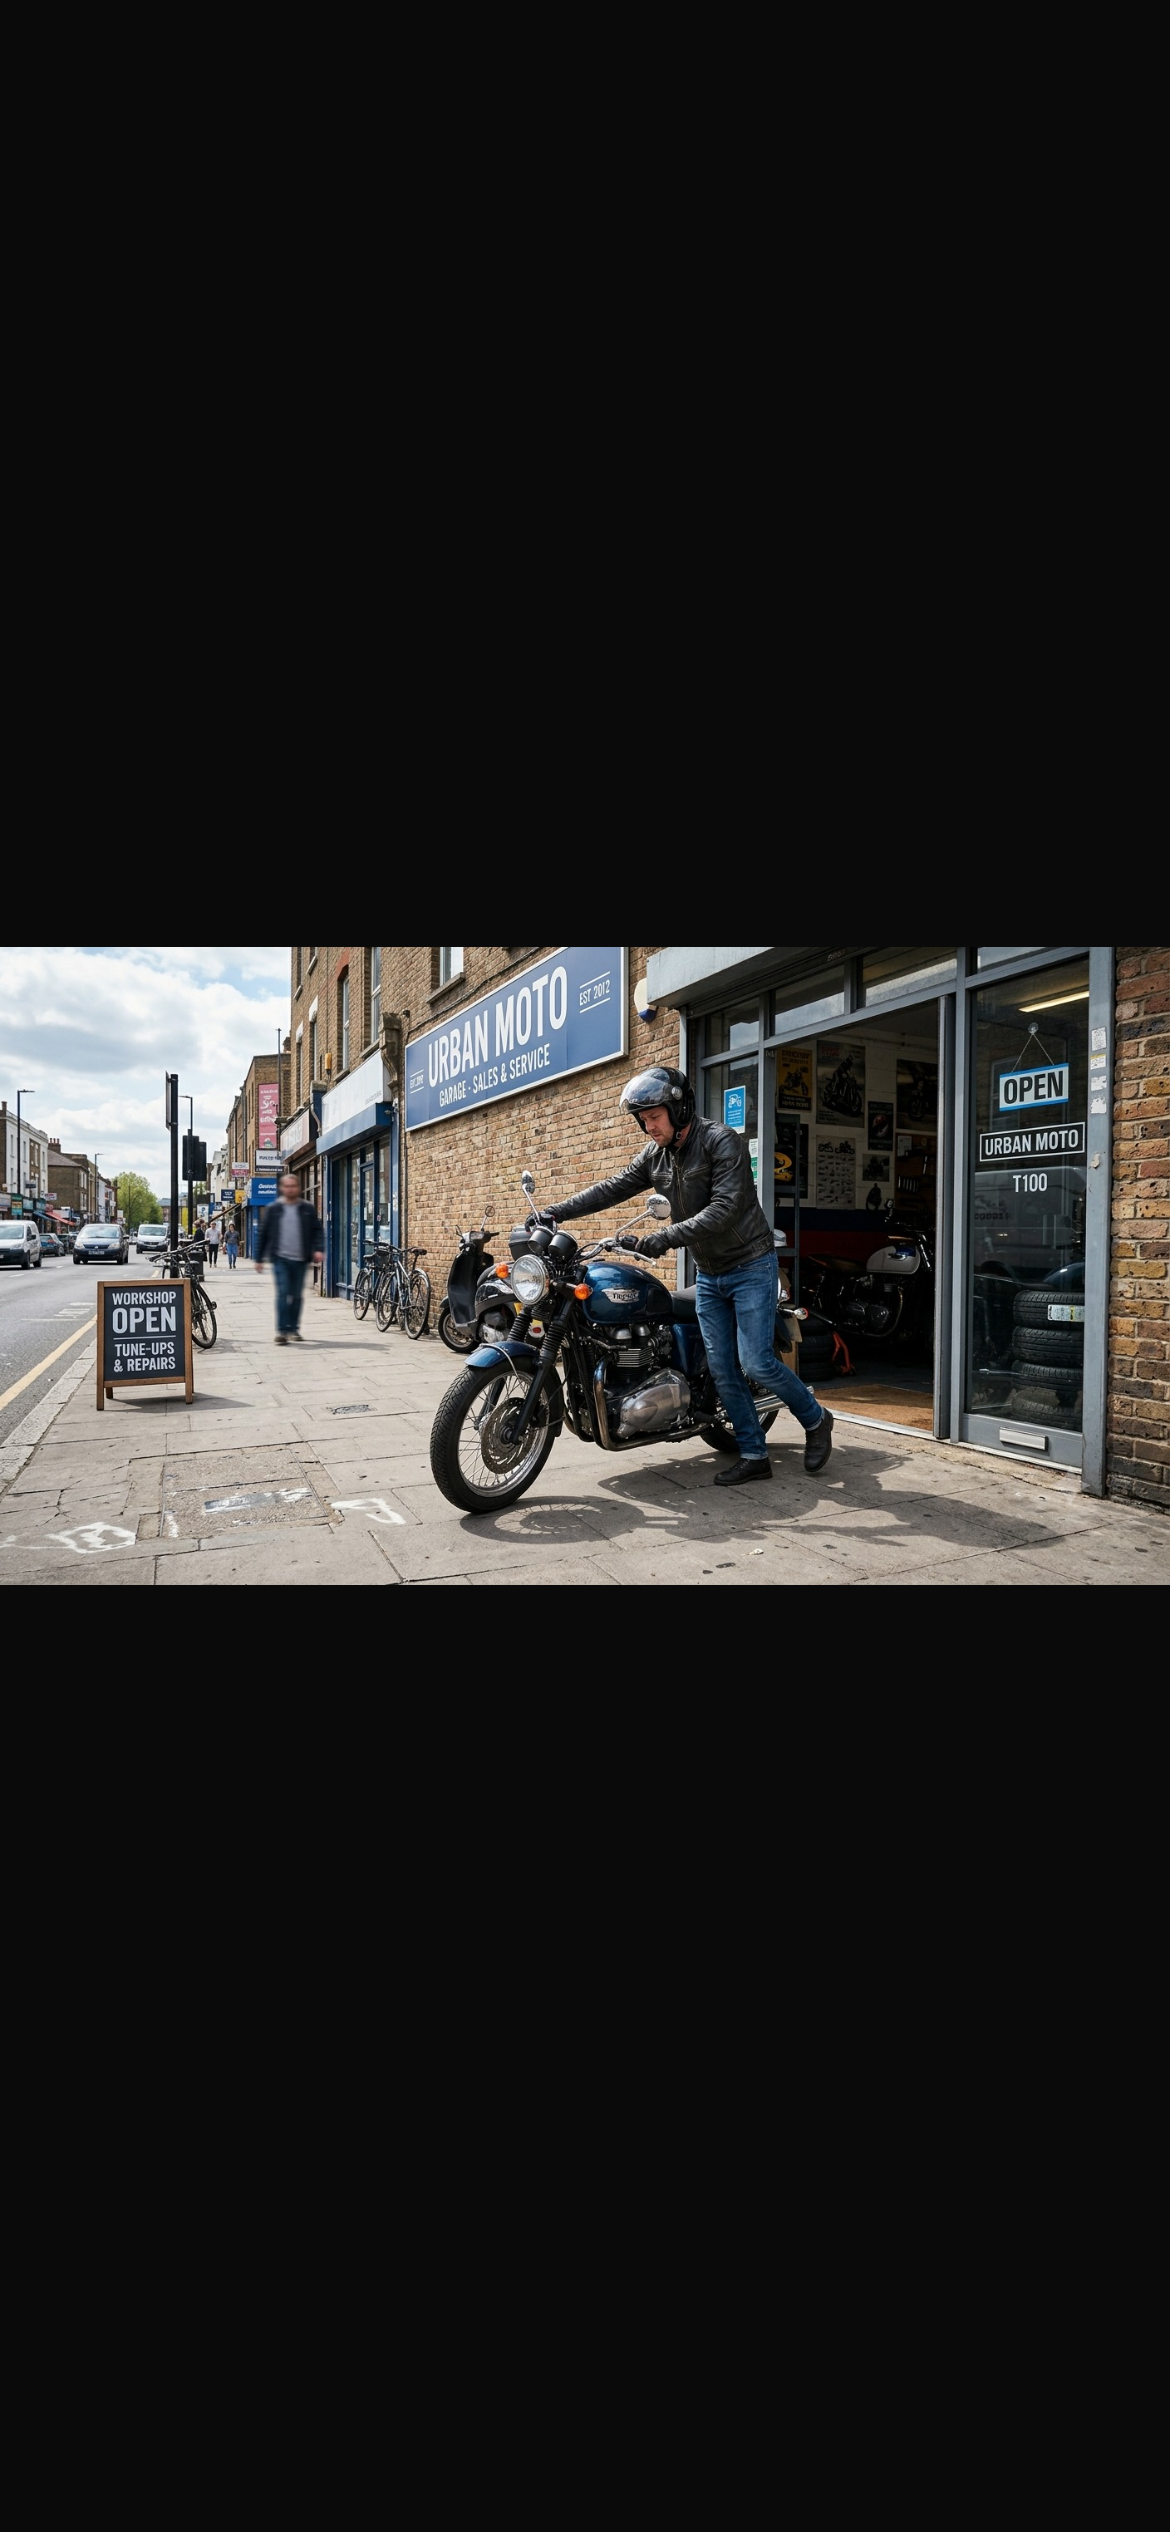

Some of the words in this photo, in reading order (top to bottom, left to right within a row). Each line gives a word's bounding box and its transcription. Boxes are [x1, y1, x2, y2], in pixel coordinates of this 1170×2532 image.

[580, 988, 591, 1006] EST
[593, 979, 610, 999] 2012
[428, 1010, 488, 1088] URBAN
[495, 966, 568, 1057] MOTO
[439, 1080, 467, 1108] GARAGE
[473, 1066, 498, 1094] SALES
[500, 1062, 508, 1083] &
[509, 1043, 550, 1079] SERVICE
[1003, 1070, 1064, 1105] OPEN
[985, 1134, 1032, 1156] URBAN
[1036, 1129, 1079, 1151] MOTO
[1012, 1173, 1048, 1193] T100
[112, 1291, 176, 1305] WORKSHOP
[112, 1306, 176, 1334] OPEN
[115, 1342, 175, 1357] TUNE-UPS
[113, 1359, 123, 1373] &
[127, 1357, 176, 1372] REPAIRS
